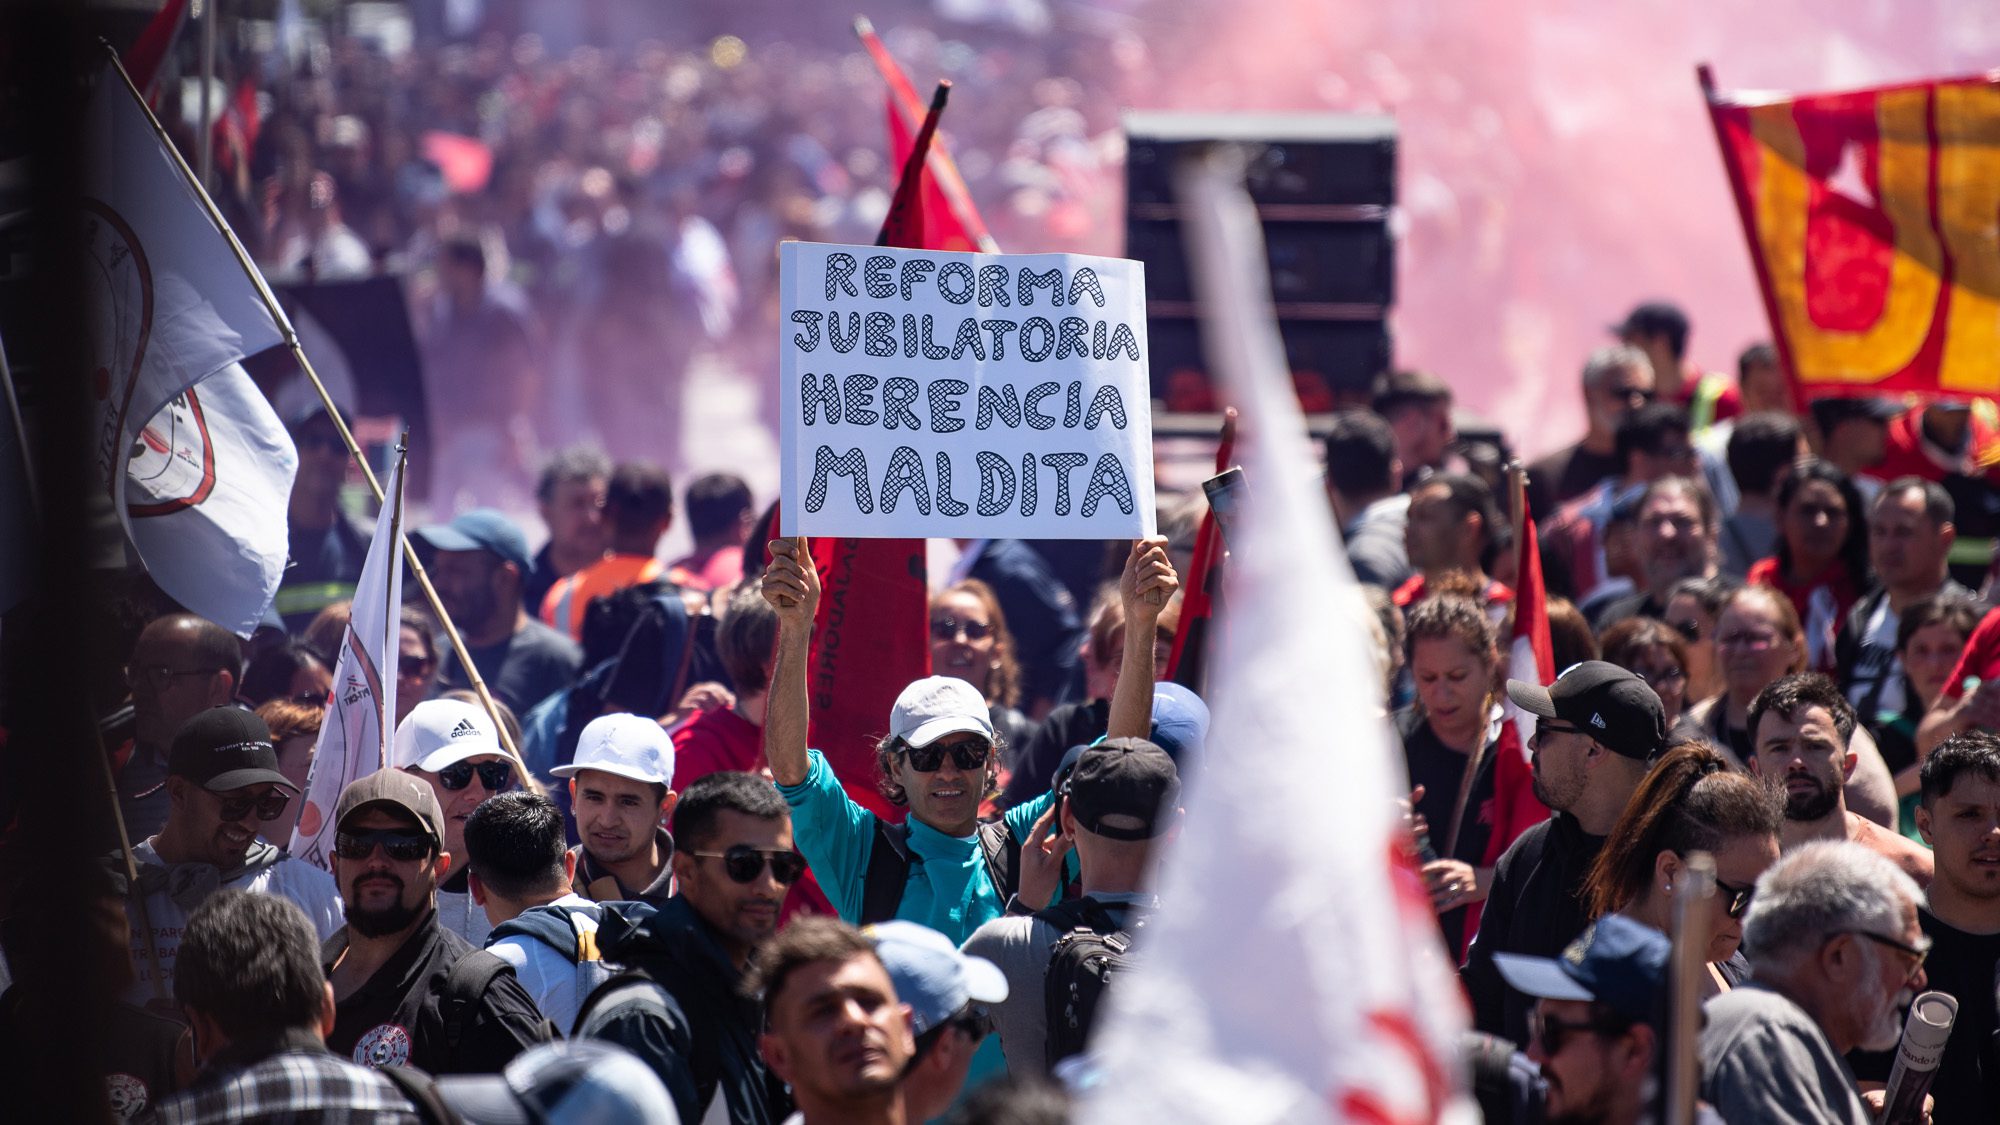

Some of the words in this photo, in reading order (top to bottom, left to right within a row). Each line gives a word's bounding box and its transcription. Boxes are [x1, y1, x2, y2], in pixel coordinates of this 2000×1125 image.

[825, 252, 1105, 307] REFORMA
[791, 310, 1140, 362] JUBILATORIA
[801, 373, 1128, 433] HERENCIA
[805, 445, 1134, 517] MALDITA
[451, 730, 482, 738] adidas
[132, 947, 177, 958] TRBA
